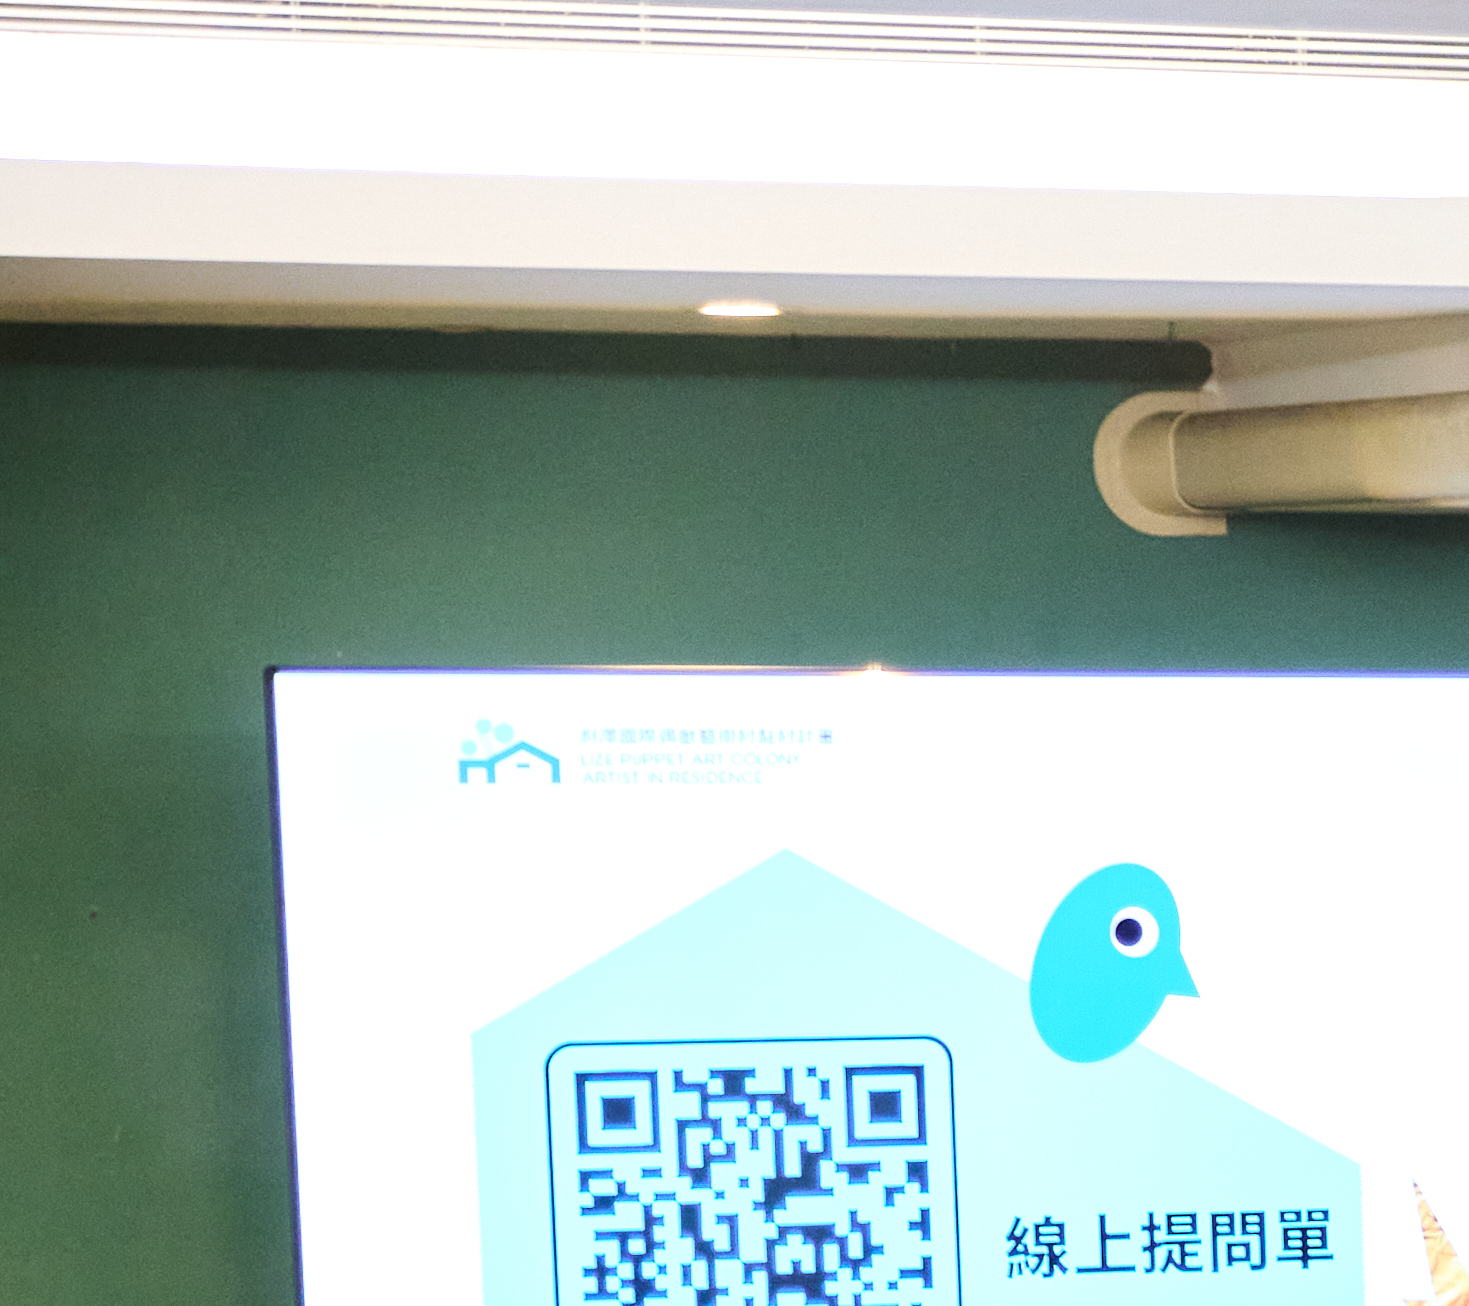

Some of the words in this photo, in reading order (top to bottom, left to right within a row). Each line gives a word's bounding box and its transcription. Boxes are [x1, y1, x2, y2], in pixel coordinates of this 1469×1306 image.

[580, 753, 614, 766] LIZE
[620, 753, 684, 766] PUPPET
[691, 753, 724, 766] ART
[731, 753, 801, 766] COLONY
[582, 771, 640, 784] ARTIST
[647, 771, 663, 784] IN
[669, 771, 763, 784] RESIDENCE
[1007, 1208, 1336, 1279] 線上提問單
